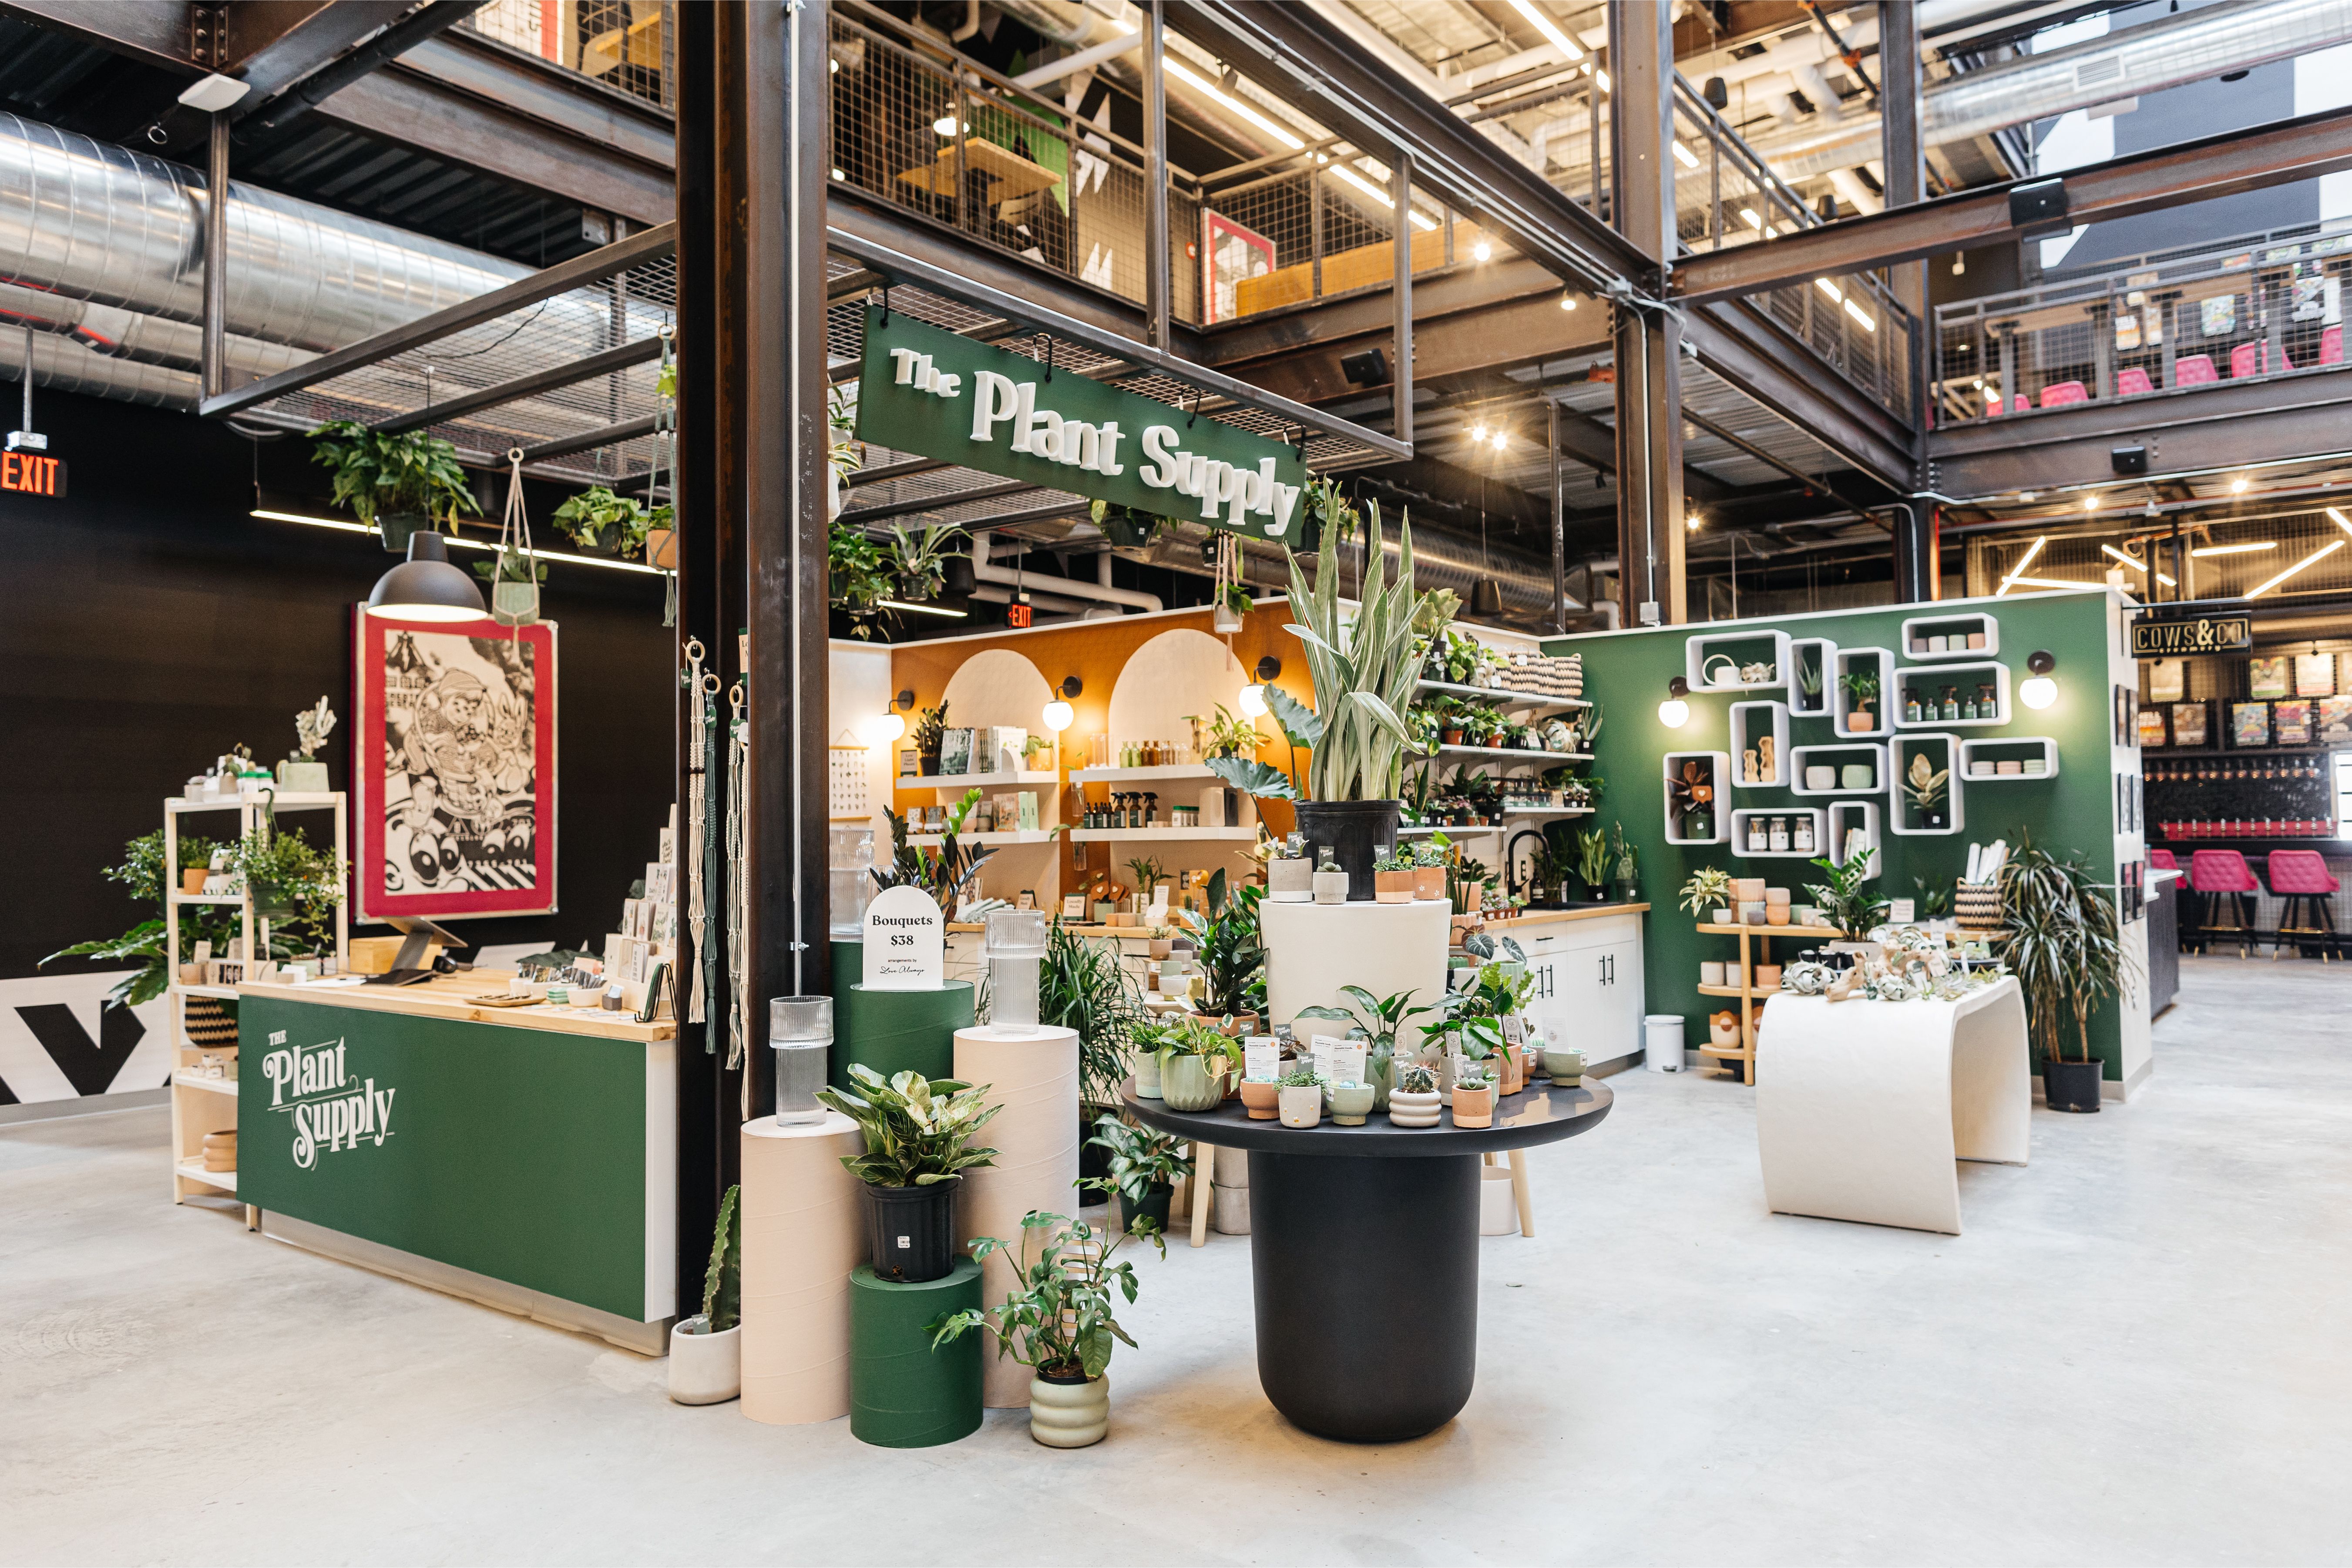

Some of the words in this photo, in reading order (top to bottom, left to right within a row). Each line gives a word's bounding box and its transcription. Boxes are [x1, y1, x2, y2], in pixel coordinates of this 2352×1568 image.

[889, 347, 961, 398] The
[970, 370, 1126, 476] Plant
[1139, 425, 1301, 536] Supply
[1, 451, 59, 495] EXIT
[1012, 604, 1032, 628] EXIT
[872, 915, 933, 928] Bouquets
[891, 935, 914, 947] $38
[899, 966, 925, 976] Always
[268, 1030, 286, 1046] THE
[262, 1036, 346, 1106] Plant
[292, 1078, 396, 1168] Supply
